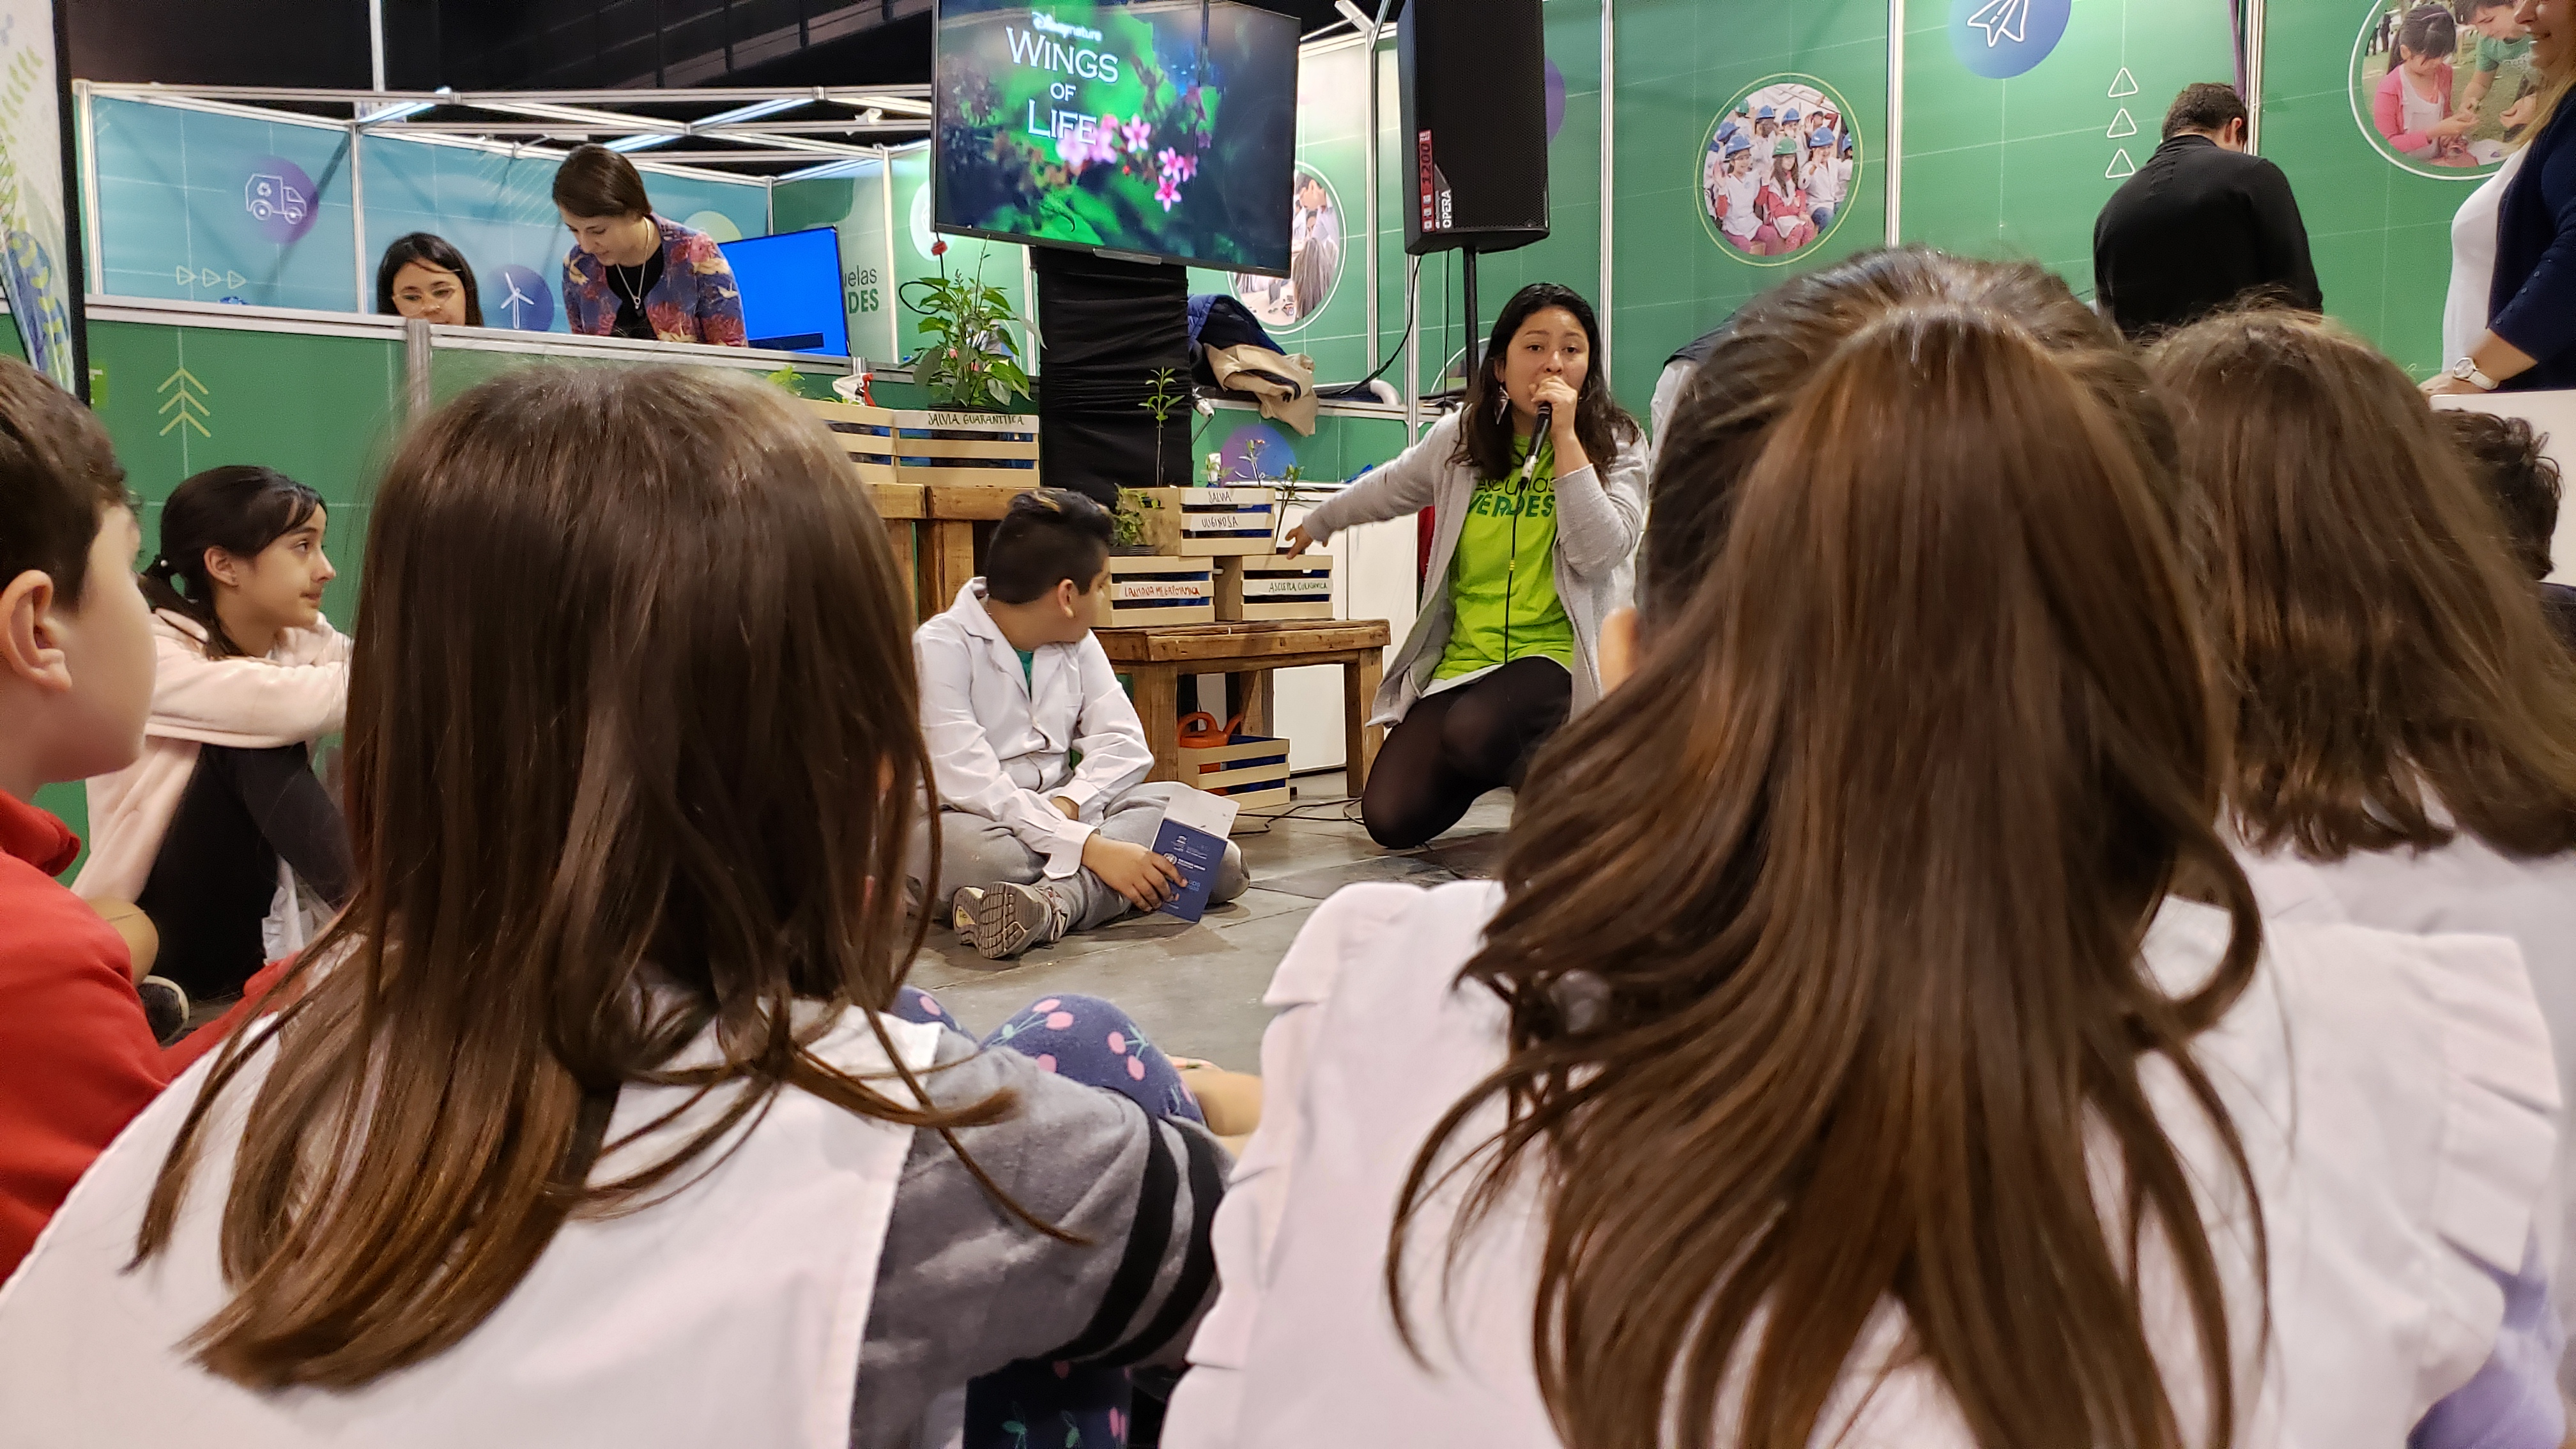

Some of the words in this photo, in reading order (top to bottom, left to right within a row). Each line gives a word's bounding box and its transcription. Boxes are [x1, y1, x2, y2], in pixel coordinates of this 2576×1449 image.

[1006, 26, 1119, 83] WINGS
[1050, 82, 1077, 102] OF
[1027, 98, 1097, 146] LIFE
[1441, 189, 1452, 229] OPERA
